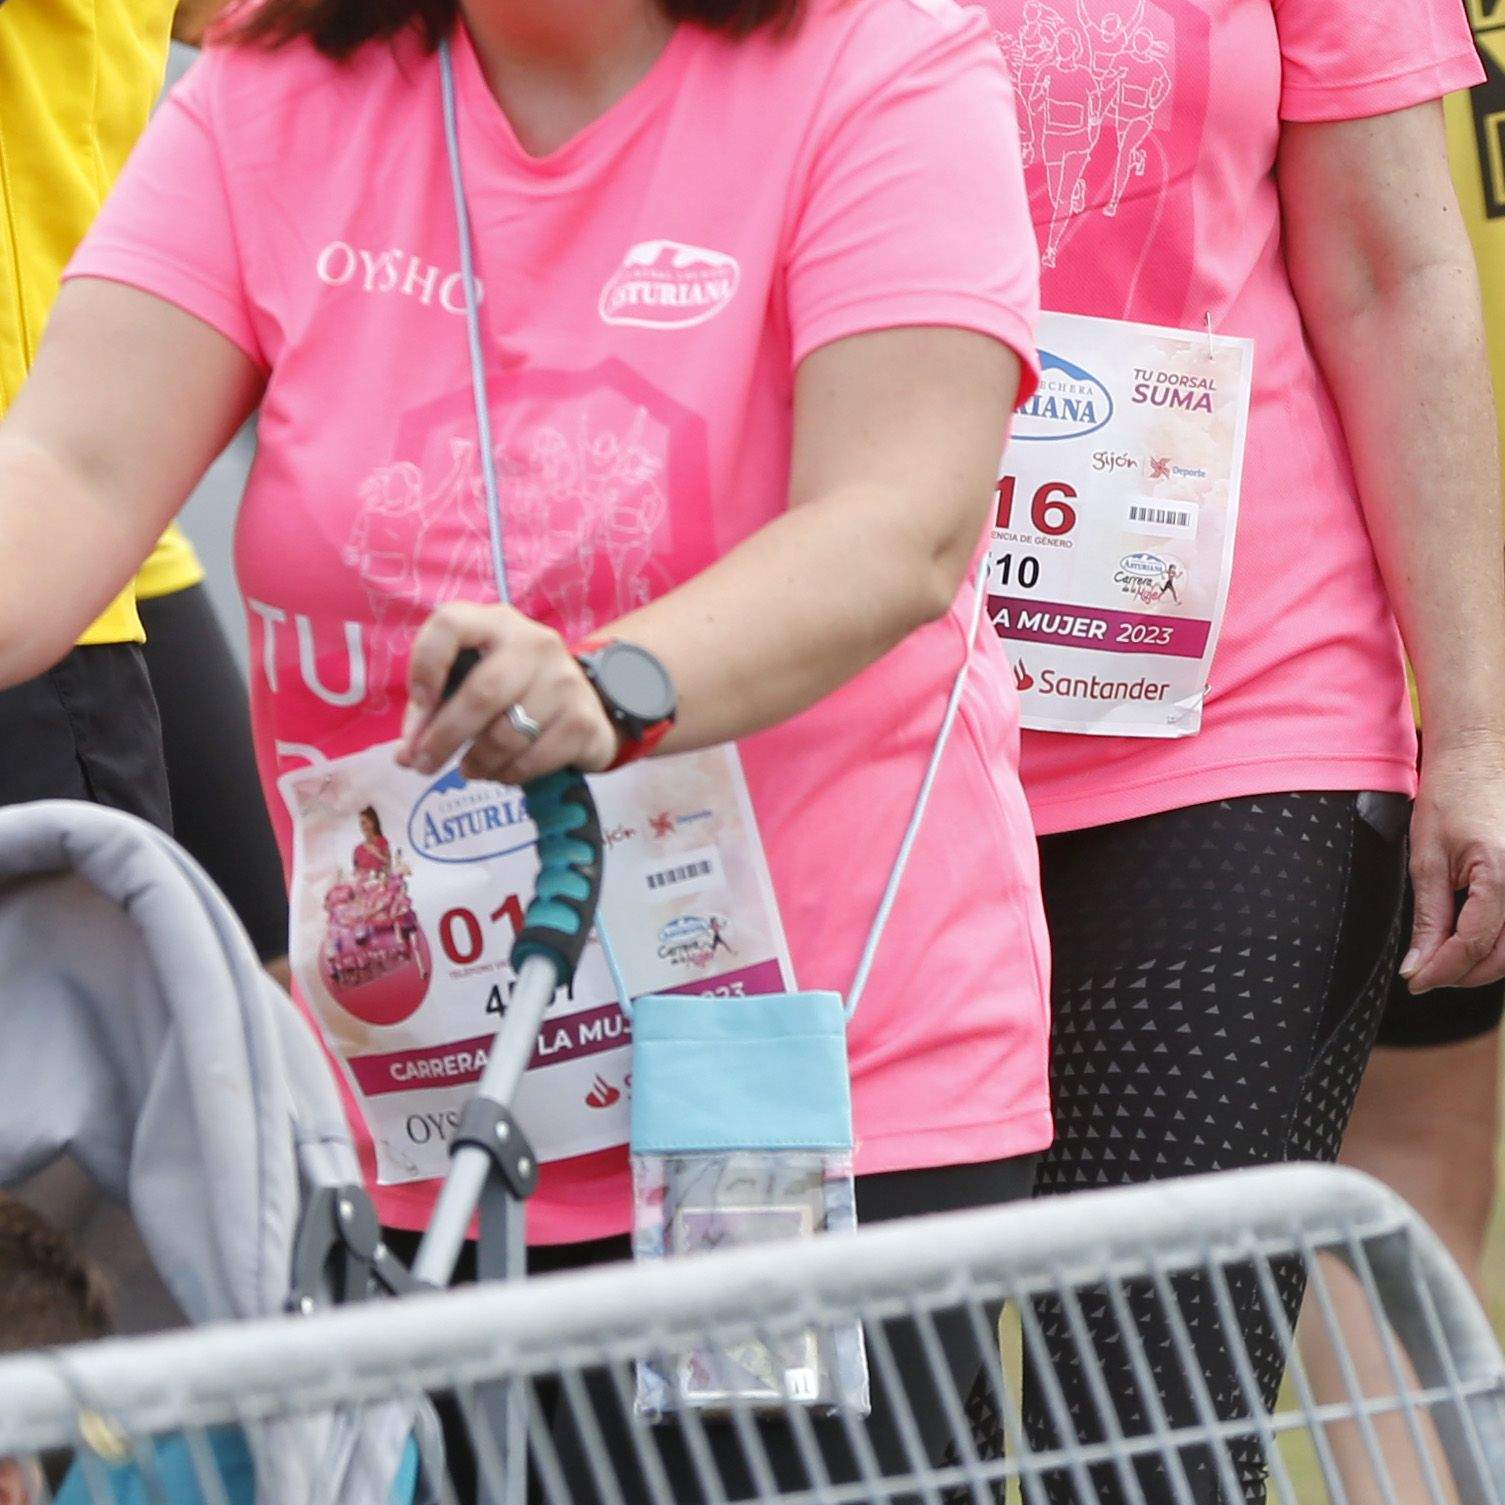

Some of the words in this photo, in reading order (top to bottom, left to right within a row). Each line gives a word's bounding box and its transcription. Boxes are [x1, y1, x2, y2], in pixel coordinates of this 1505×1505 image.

[1039, 381, 1094, 396] ECHERA
[1133, 368, 1152, 381] TU
[1155, 370, 1218, 391] DORSAL
[1132, 383, 1213, 413] SUMA
[994, 475, 1078, 536] 16
[991, 531, 1019, 543] ENCIA
[1020, 534, 1033, 544] DE
[1034, 534, 1073, 549] GÉNERO
[992, 553, 1040, 589] 10
[992, 608, 1010, 628] A
[1017, 610, 1108, 640] MUJER
[1116, 623, 1174, 646] 2023
[249, 597, 368, 708] TU
[1038, 669, 1171, 701] Santander
[439, 894, 526, 965] 01
[390, 1048, 490, 1081] CARRERA
[538, 1028, 573, 1056] LA
[406, 1110, 462, 1145] OYS
